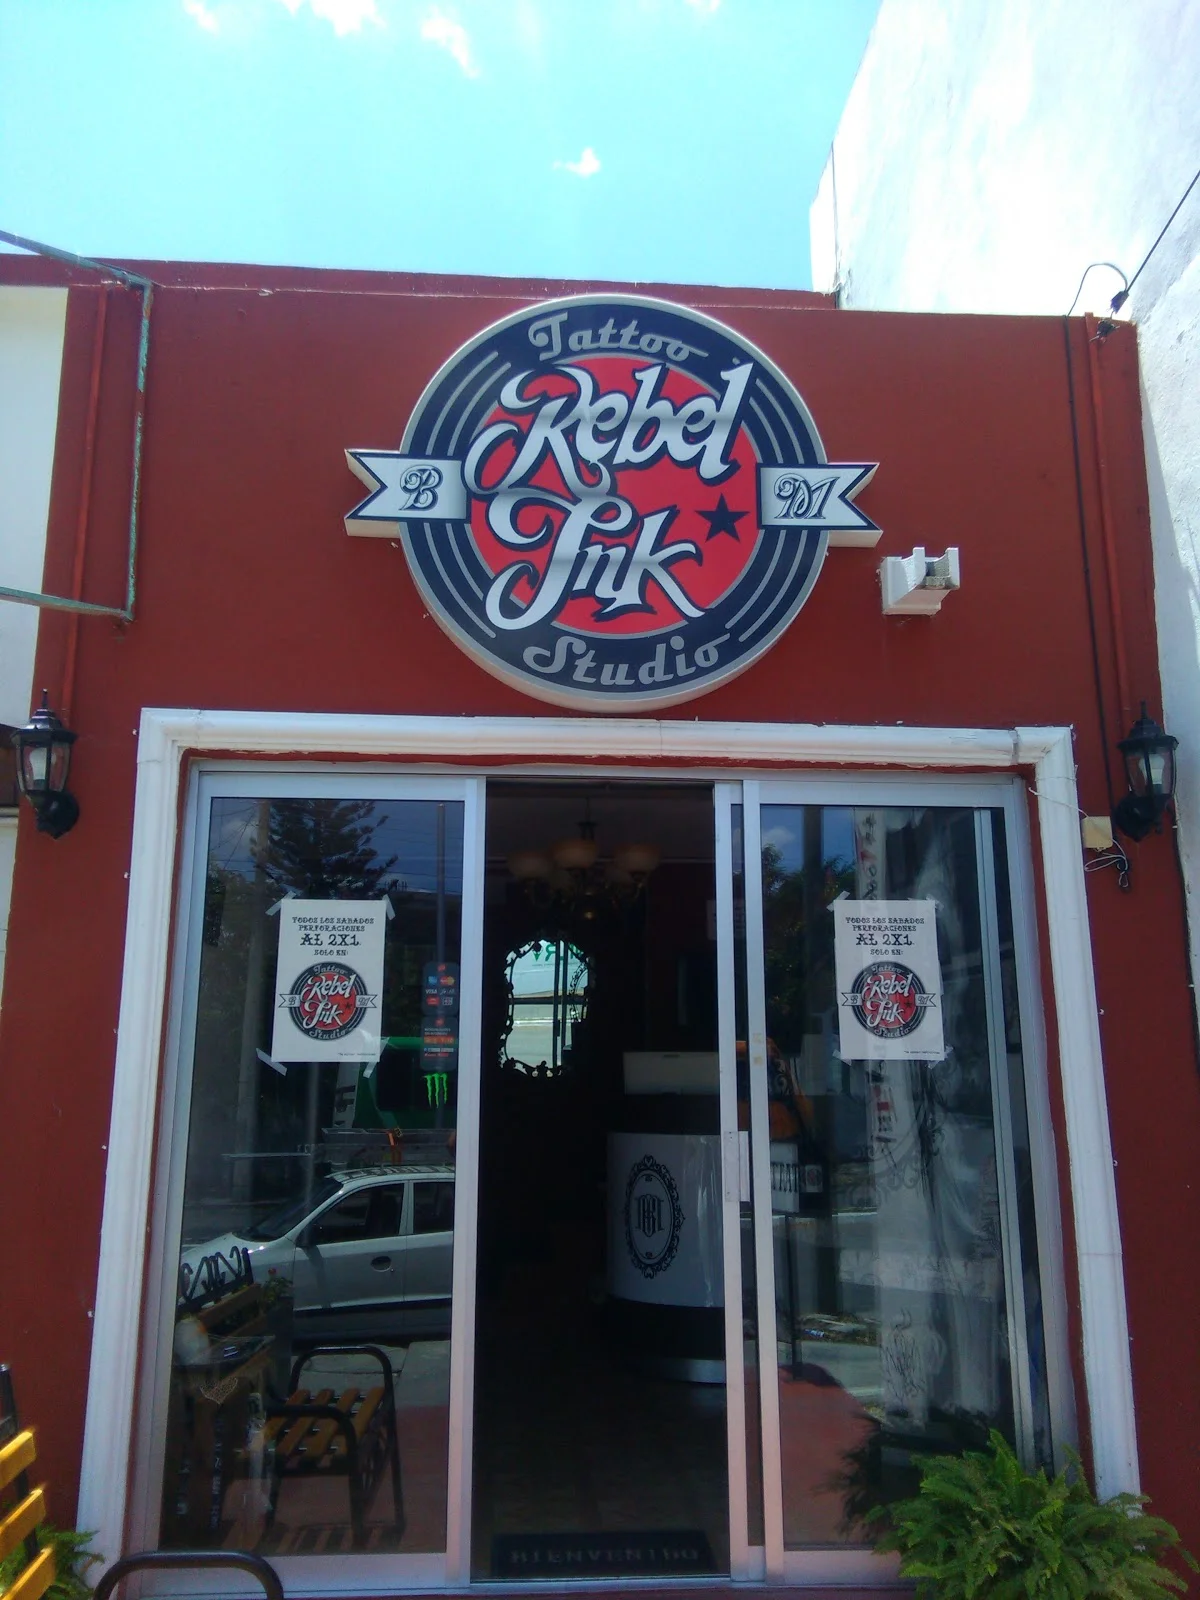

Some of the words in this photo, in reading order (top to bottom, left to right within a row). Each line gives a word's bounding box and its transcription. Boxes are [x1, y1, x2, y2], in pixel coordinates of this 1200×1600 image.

[528, 312, 709, 361] Tattoo
[464, 362, 754, 498] Rebel
[399, 463, 445, 512] B
[484, 490, 704, 630] Ink
[523, 634, 731, 686] Studio
[292, 916, 318, 924] TODOS
[320, 916, 335, 924] LOS
[336, 917, 375, 925] SABADOS
[298, 924, 366, 932] PERFORACIONES
[845, 916, 871, 924] TODOS
[872, 916, 887, 924] LOS
[888, 917, 925, 925] SABADOS
[852, 924, 917, 932] PERFORACIONES
[300, 933, 324, 946] AL
[855, 933, 878, 946] AL
[870, 948, 890, 956] SOLO
[301, 973, 357, 1002] Rebel
[862, 973, 913, 1001] Rebel
